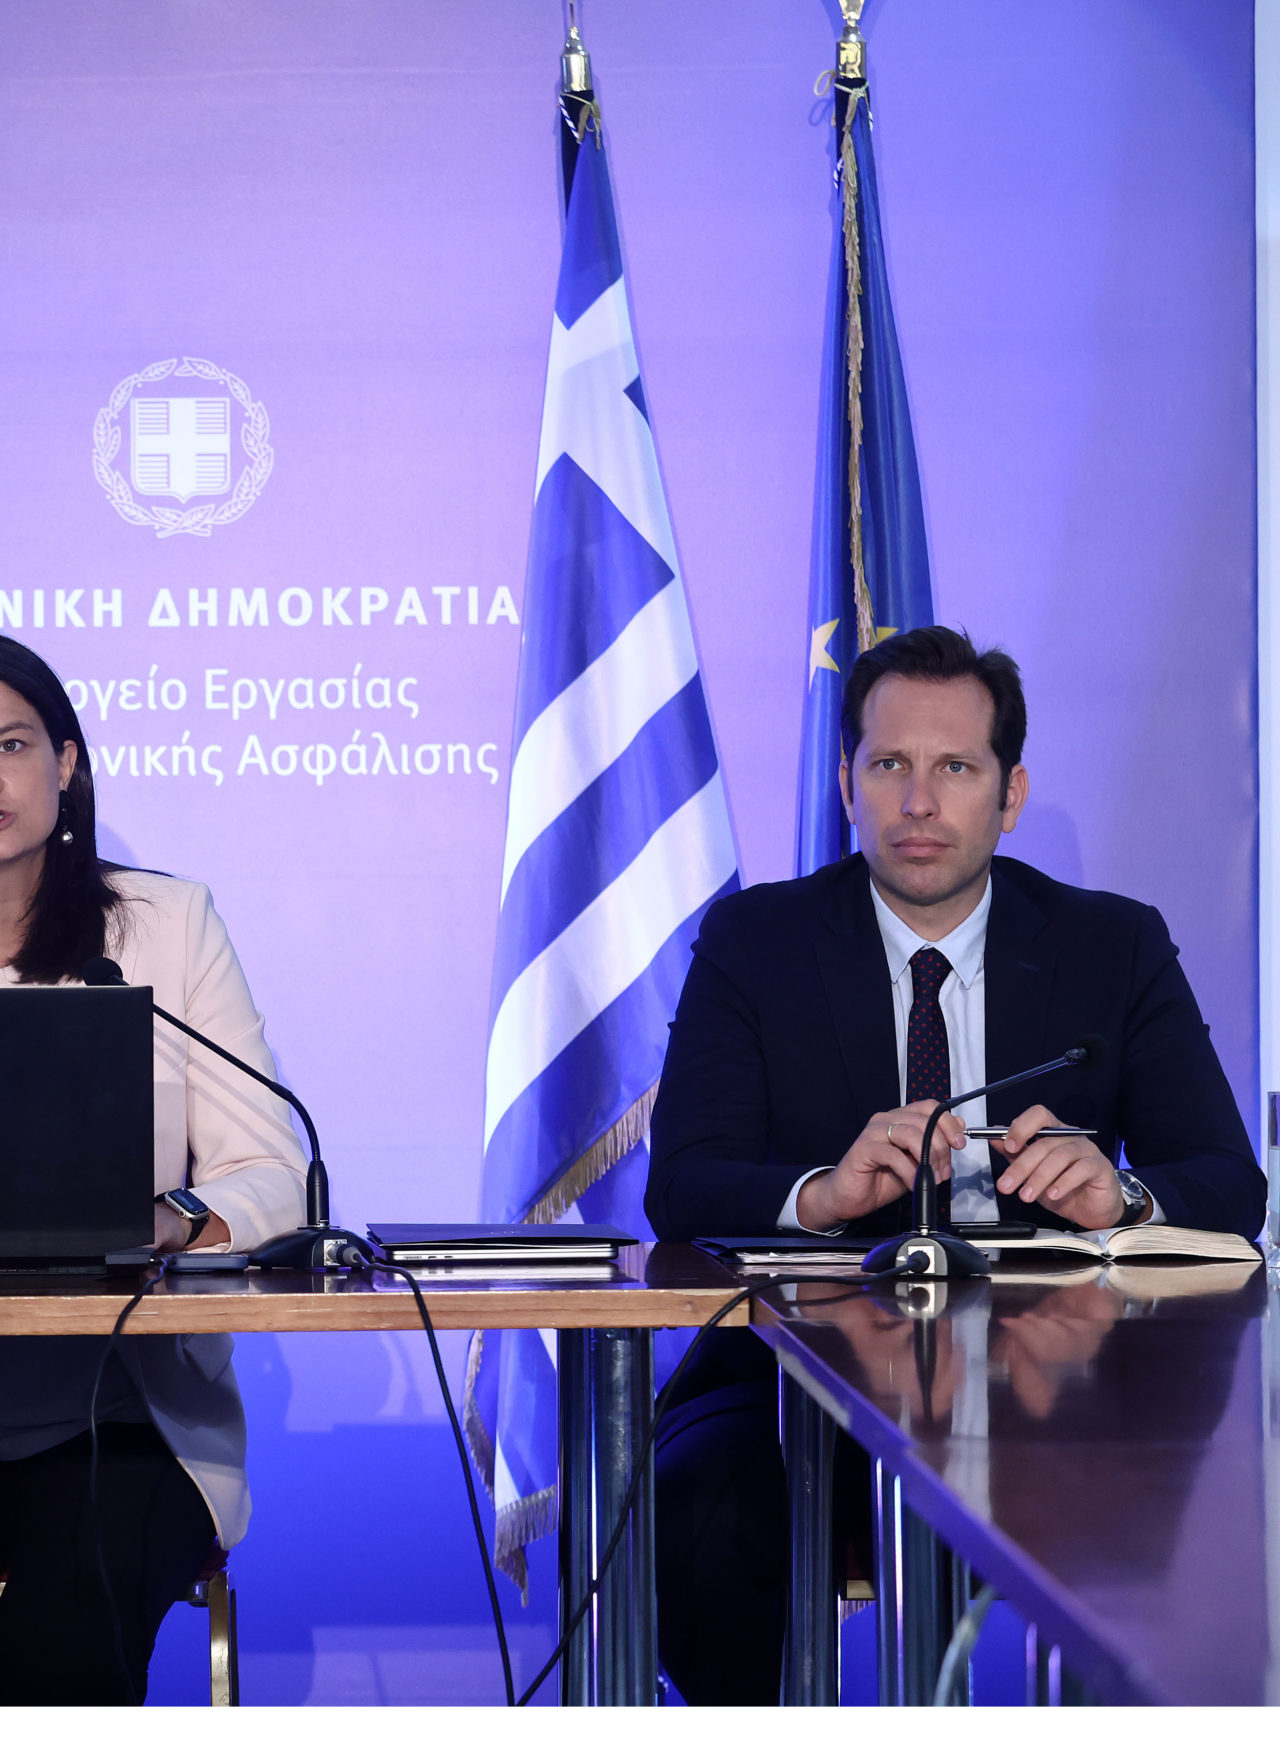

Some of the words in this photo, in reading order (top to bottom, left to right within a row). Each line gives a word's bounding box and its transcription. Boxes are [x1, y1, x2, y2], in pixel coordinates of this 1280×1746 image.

[148, 585, 521, 627] ΔΗΜΟΚΡΑΤΙΑ
[204, 663, 418, 719] Εργασίας
[237, 730, 498, 785] Ασφάλισης
